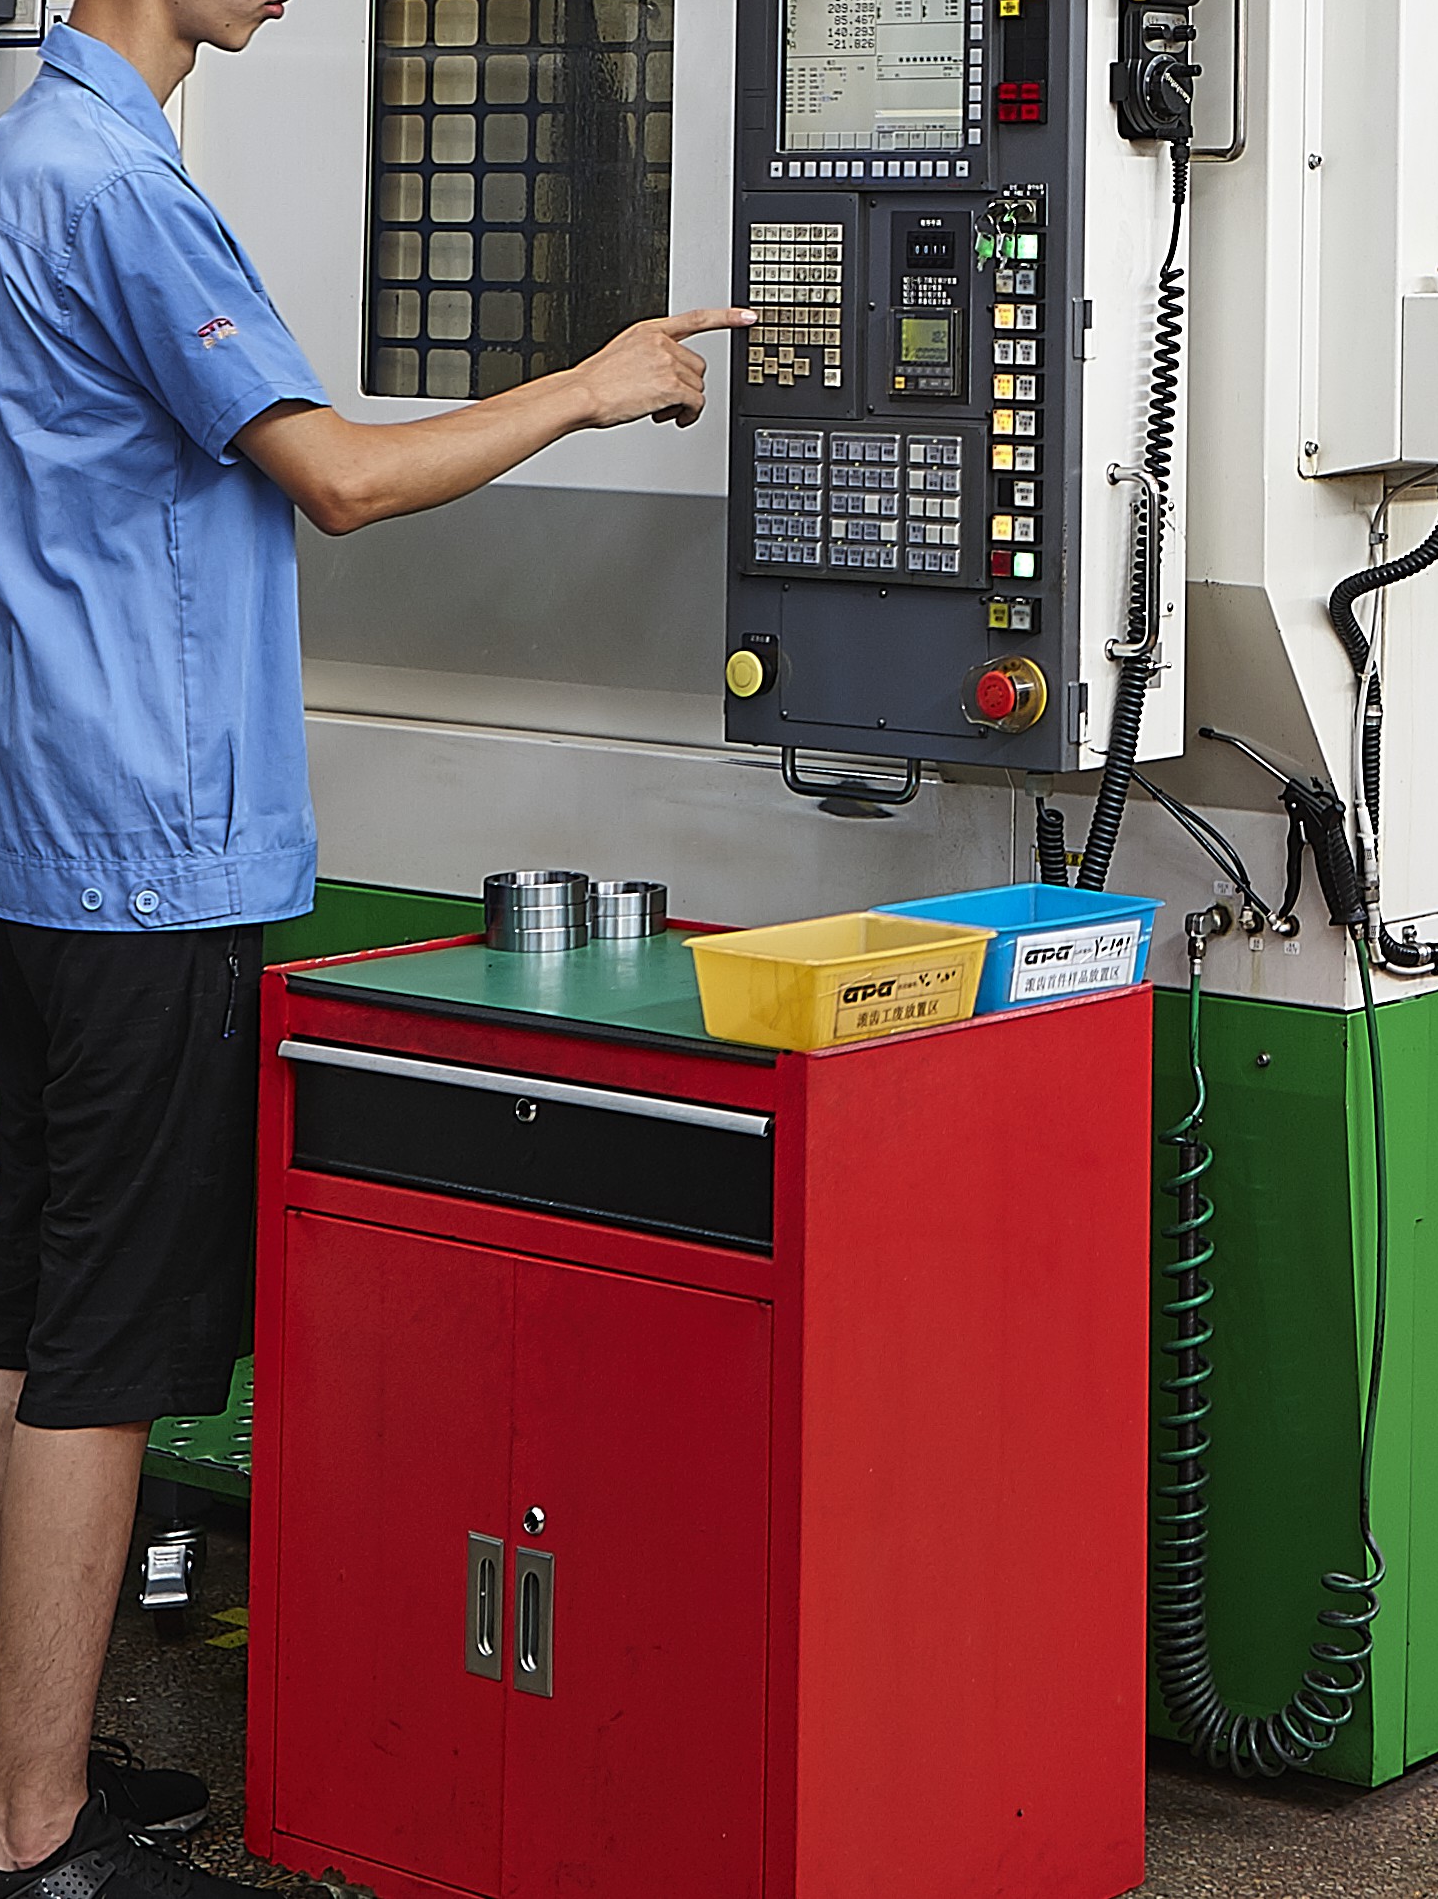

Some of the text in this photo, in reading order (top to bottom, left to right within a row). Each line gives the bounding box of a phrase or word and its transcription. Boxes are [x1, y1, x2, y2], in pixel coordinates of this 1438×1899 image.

[833, 15, 875, 26] 85.467
[827, 27, 875, 38] 140.293
[827, 39, 875, 51] -21.826
[1024, 965, 1121, 993] 滚齿首件样品放置区
